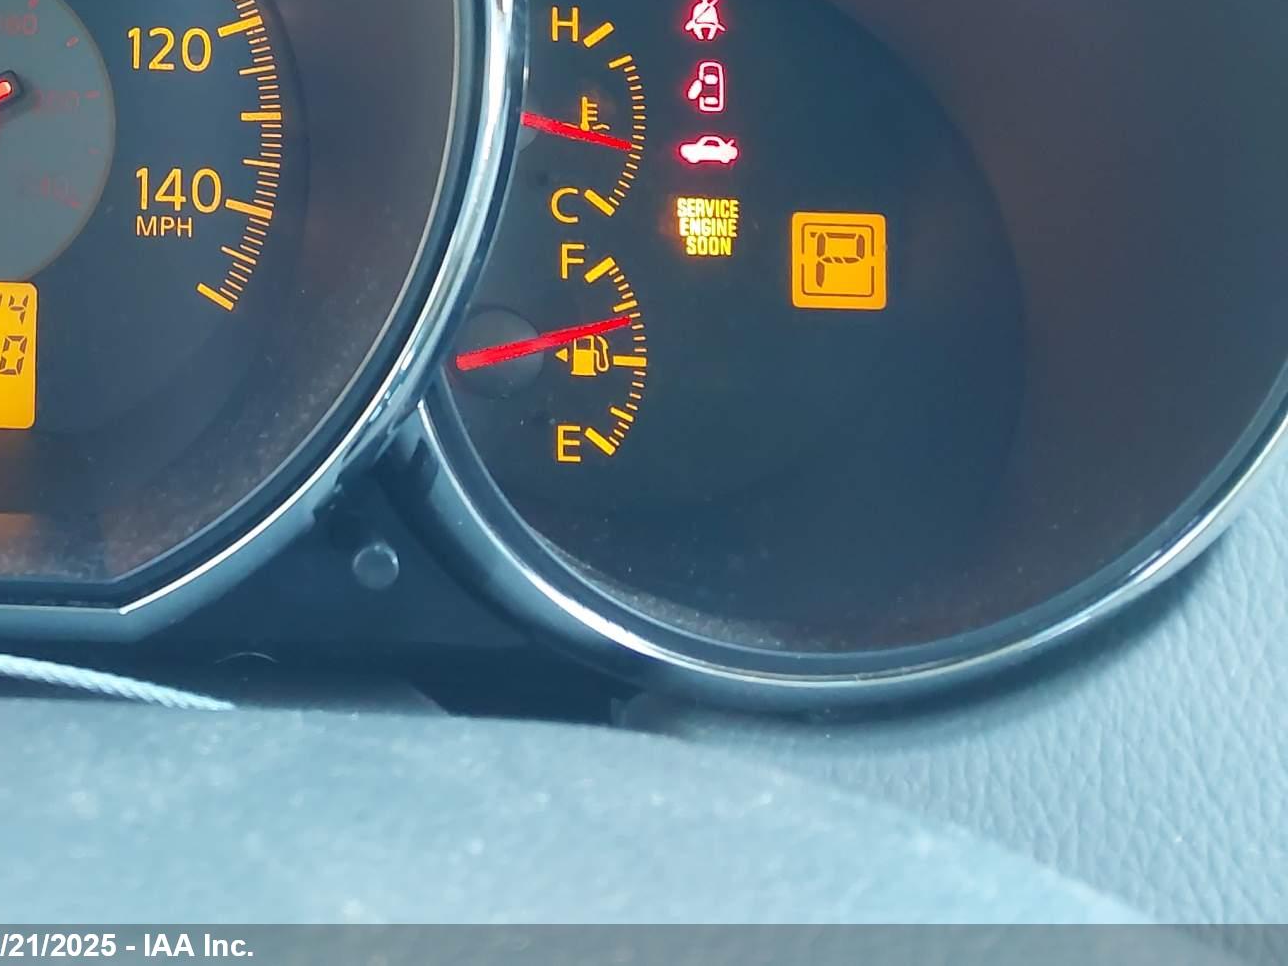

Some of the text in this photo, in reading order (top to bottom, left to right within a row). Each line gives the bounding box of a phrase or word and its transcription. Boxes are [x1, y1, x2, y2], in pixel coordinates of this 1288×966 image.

[551, 7, 579, 42] H
[128, 27, 212, 72] 120
[136, 167, 222, 213] 140
[551, 187, 579, 223] C
[677, 197, 739, 218] SERVICE
[136, 216, 192, 236] MPH
[679, 217, 737, 237] ENGINE
[561, 243, 587, 279] F
[686, 235, 732, 256] SOON
[809, 231, 866, 288] P
[557, 425, 581, 462] E
